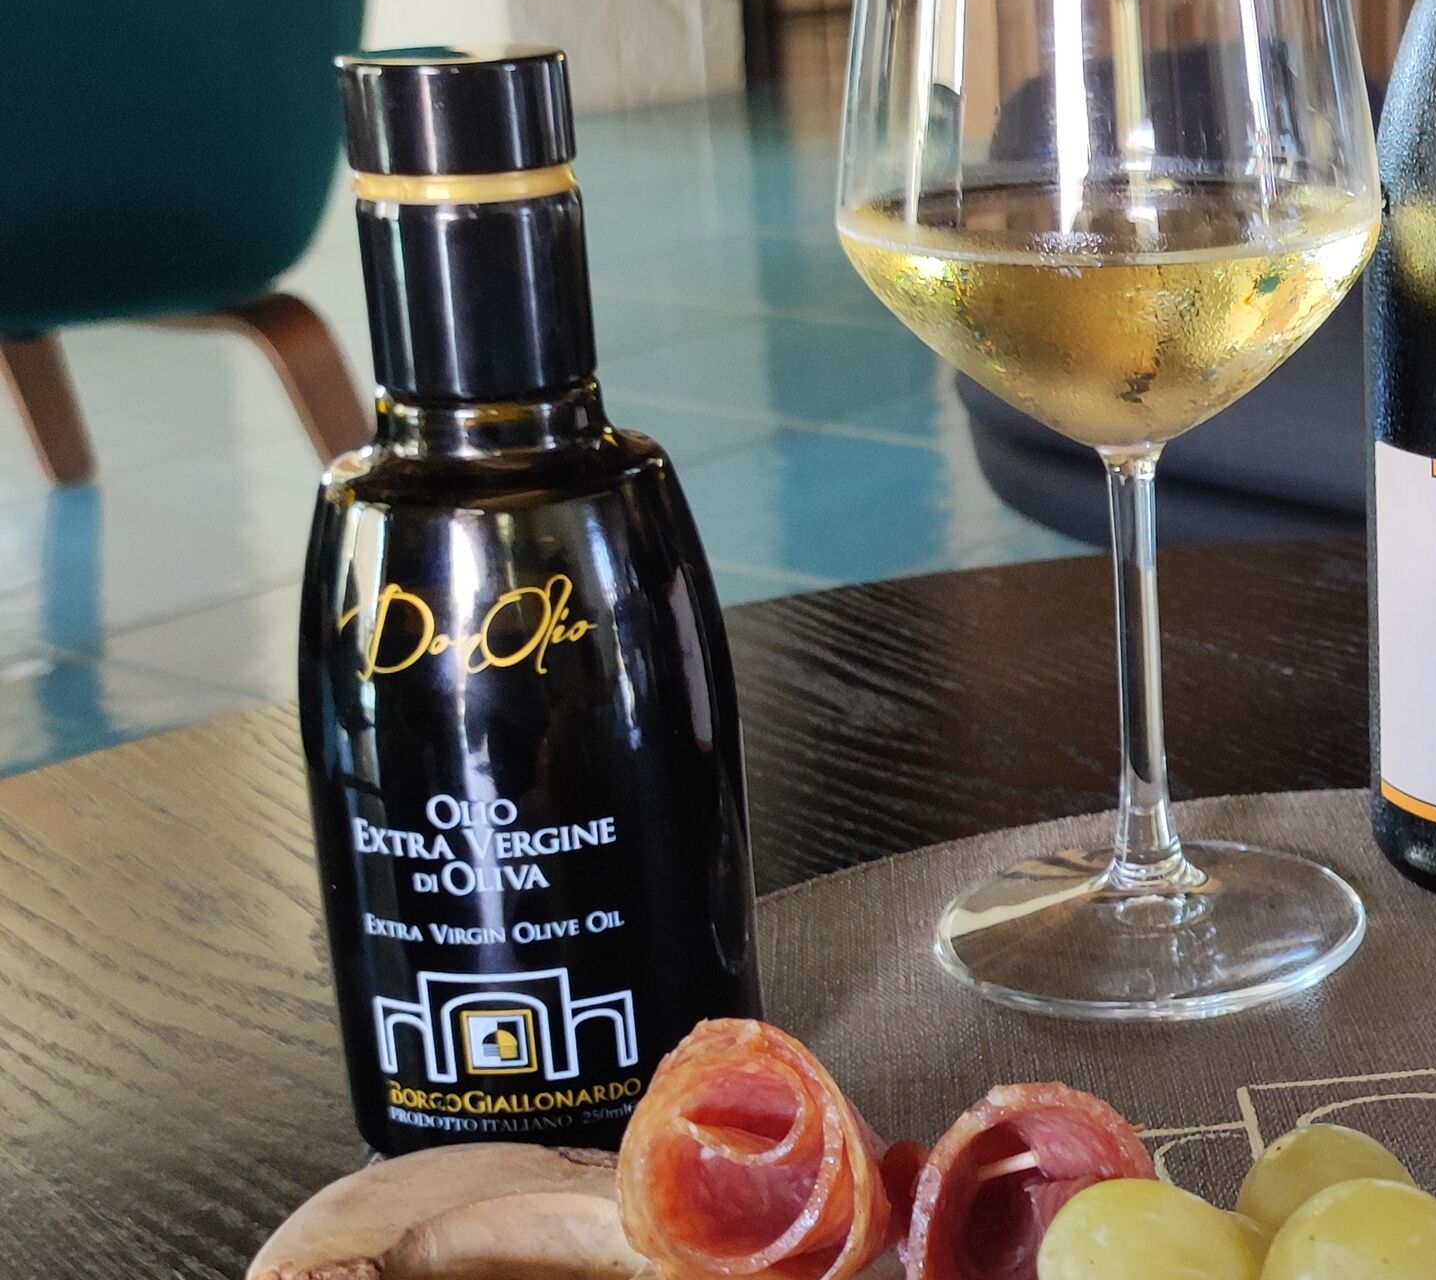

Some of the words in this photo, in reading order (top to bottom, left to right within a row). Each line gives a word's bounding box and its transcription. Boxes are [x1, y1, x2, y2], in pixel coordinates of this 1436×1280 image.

[426, 794, 518, 830] OLIO
[353, 816, 456, 860] EXTRA
[462, 816, 617, 862] VERGINE
[411, 872, 439, 893] DI
[441, 860, 550, 896] OLIVA
[362, 912, 424, 942] EXTRA
[429, 923, 506, 945] VIRGIN
[512, 917, 580, 944] OLIVE
[585, 910, 625, 933] OIL
[387, 1106, 478, 1133] PRODOTTO
[482, 1114, 573, 1133] ITALIANO
